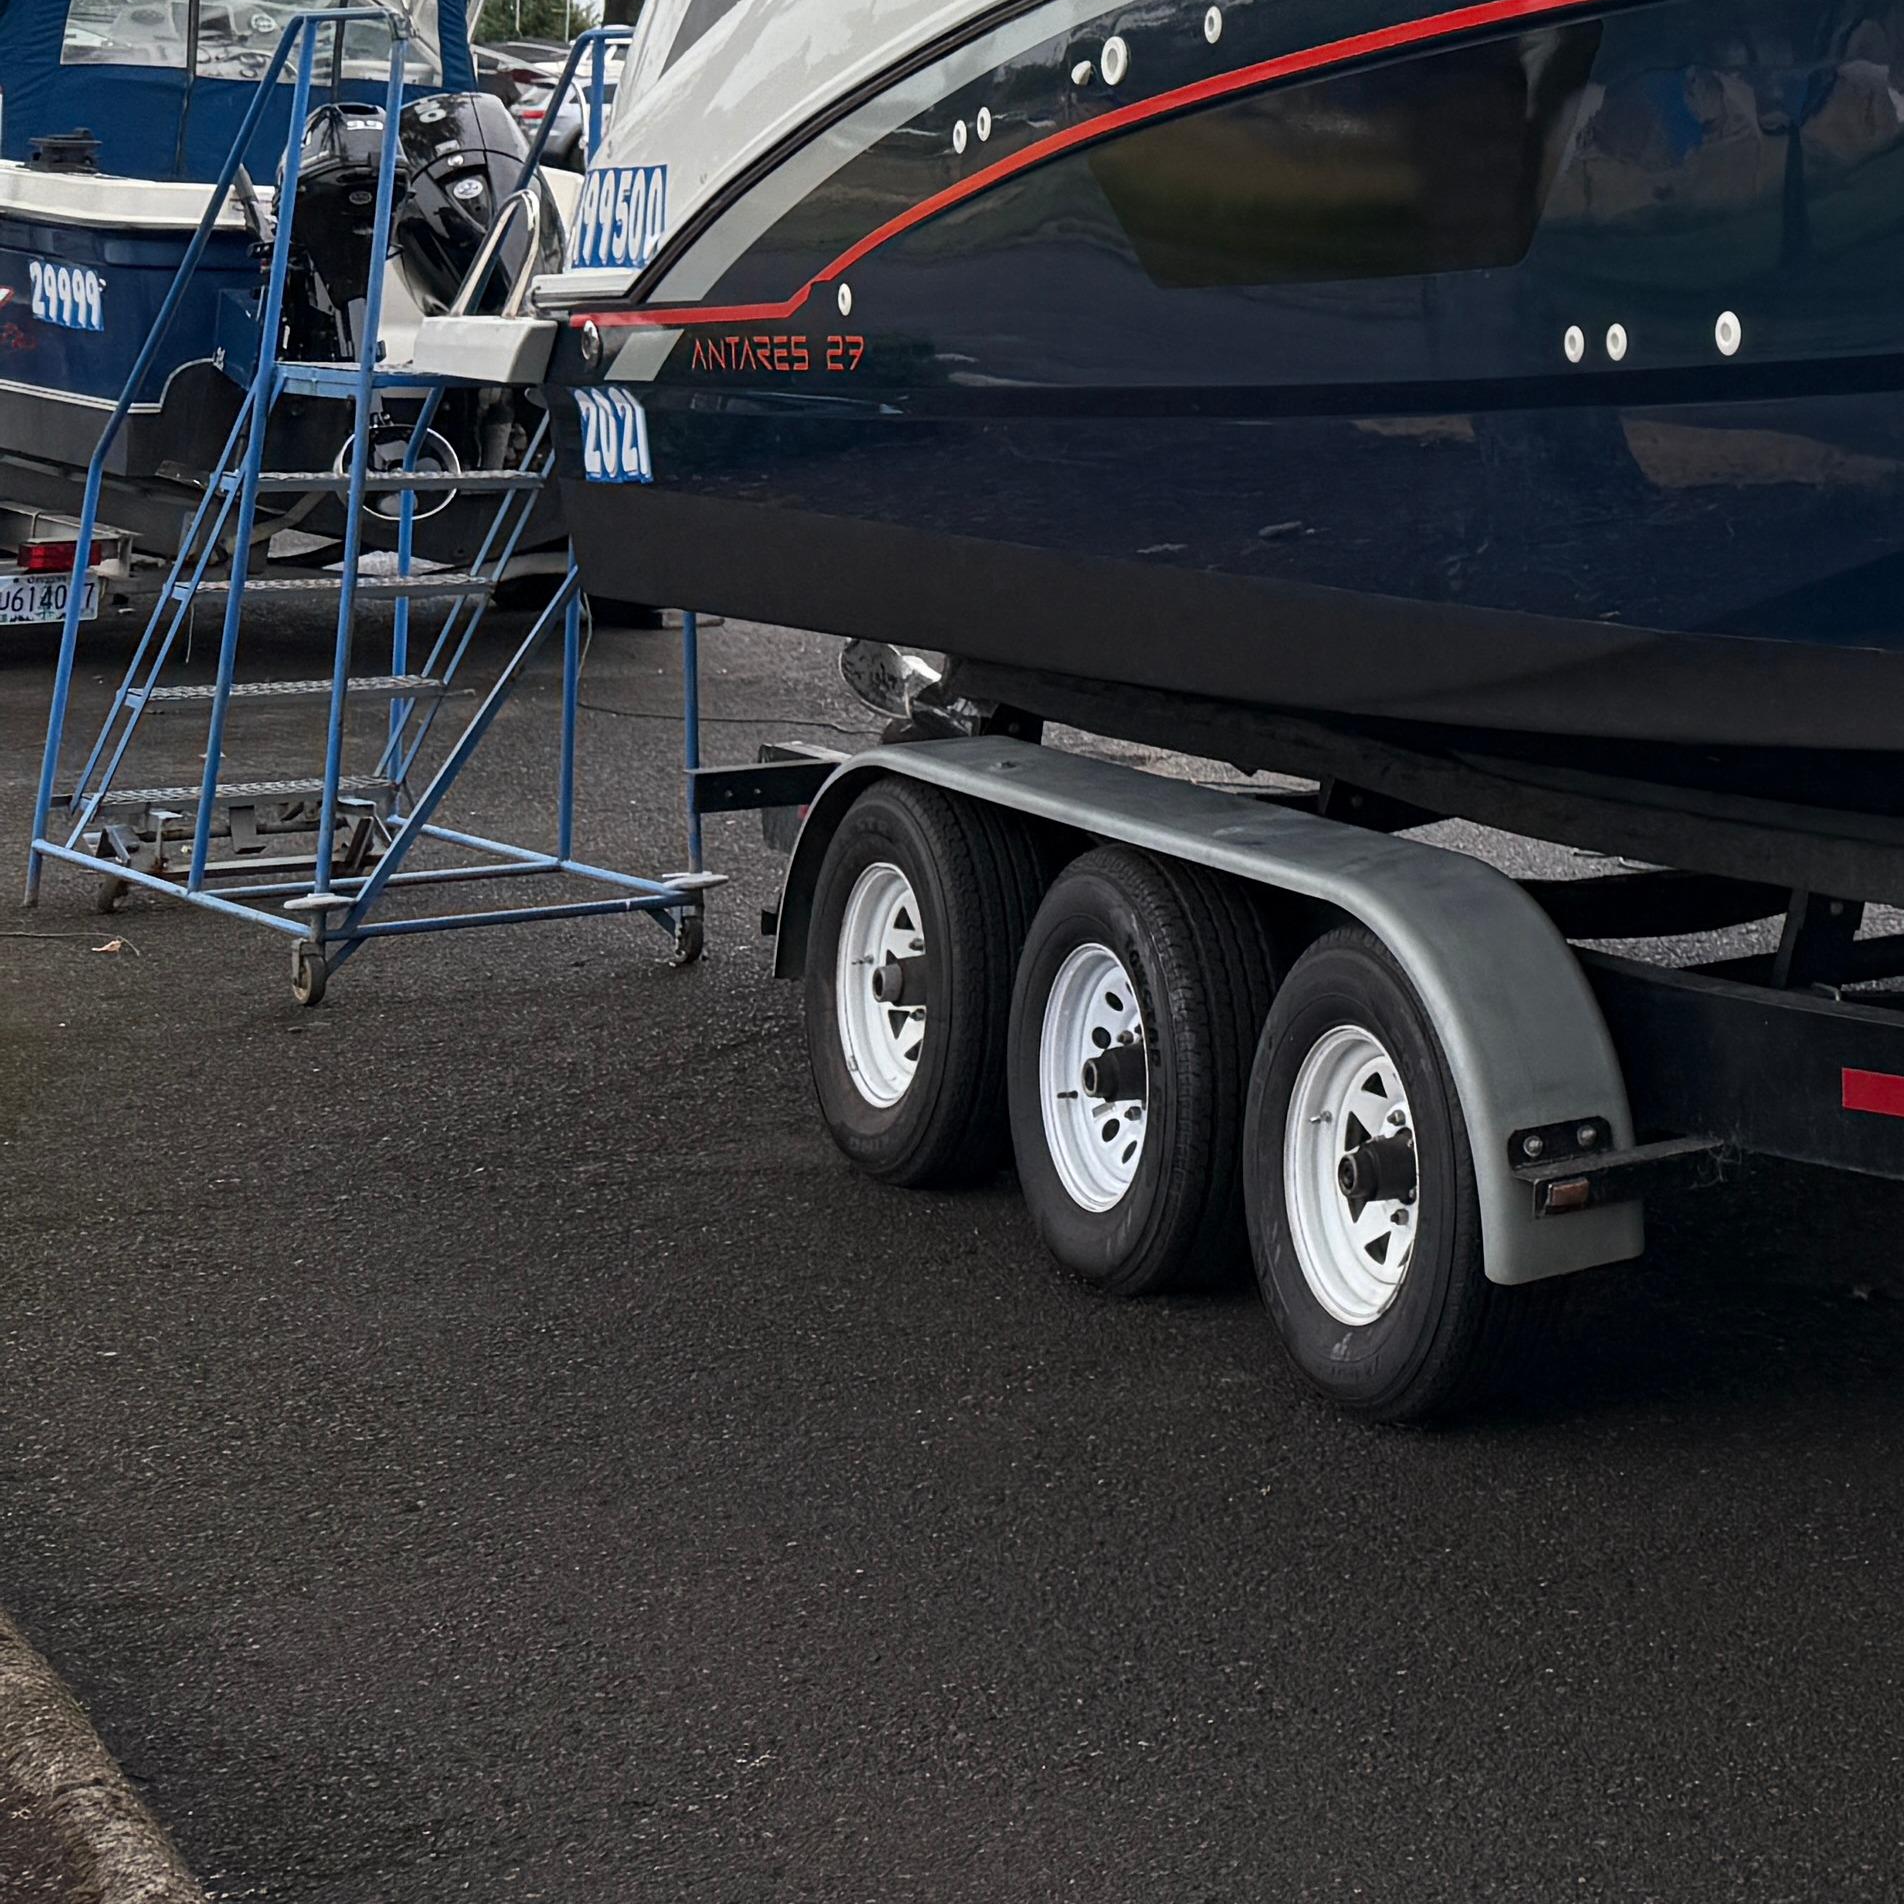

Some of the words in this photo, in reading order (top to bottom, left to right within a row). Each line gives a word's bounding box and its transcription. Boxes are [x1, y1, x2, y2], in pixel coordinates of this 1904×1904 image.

[29, 261, 102, 332] 29999
[691, 335, 809, 371] ANTARES
[826, 335, 865, 371] 27
[574, 386, 652, 478] 2021
